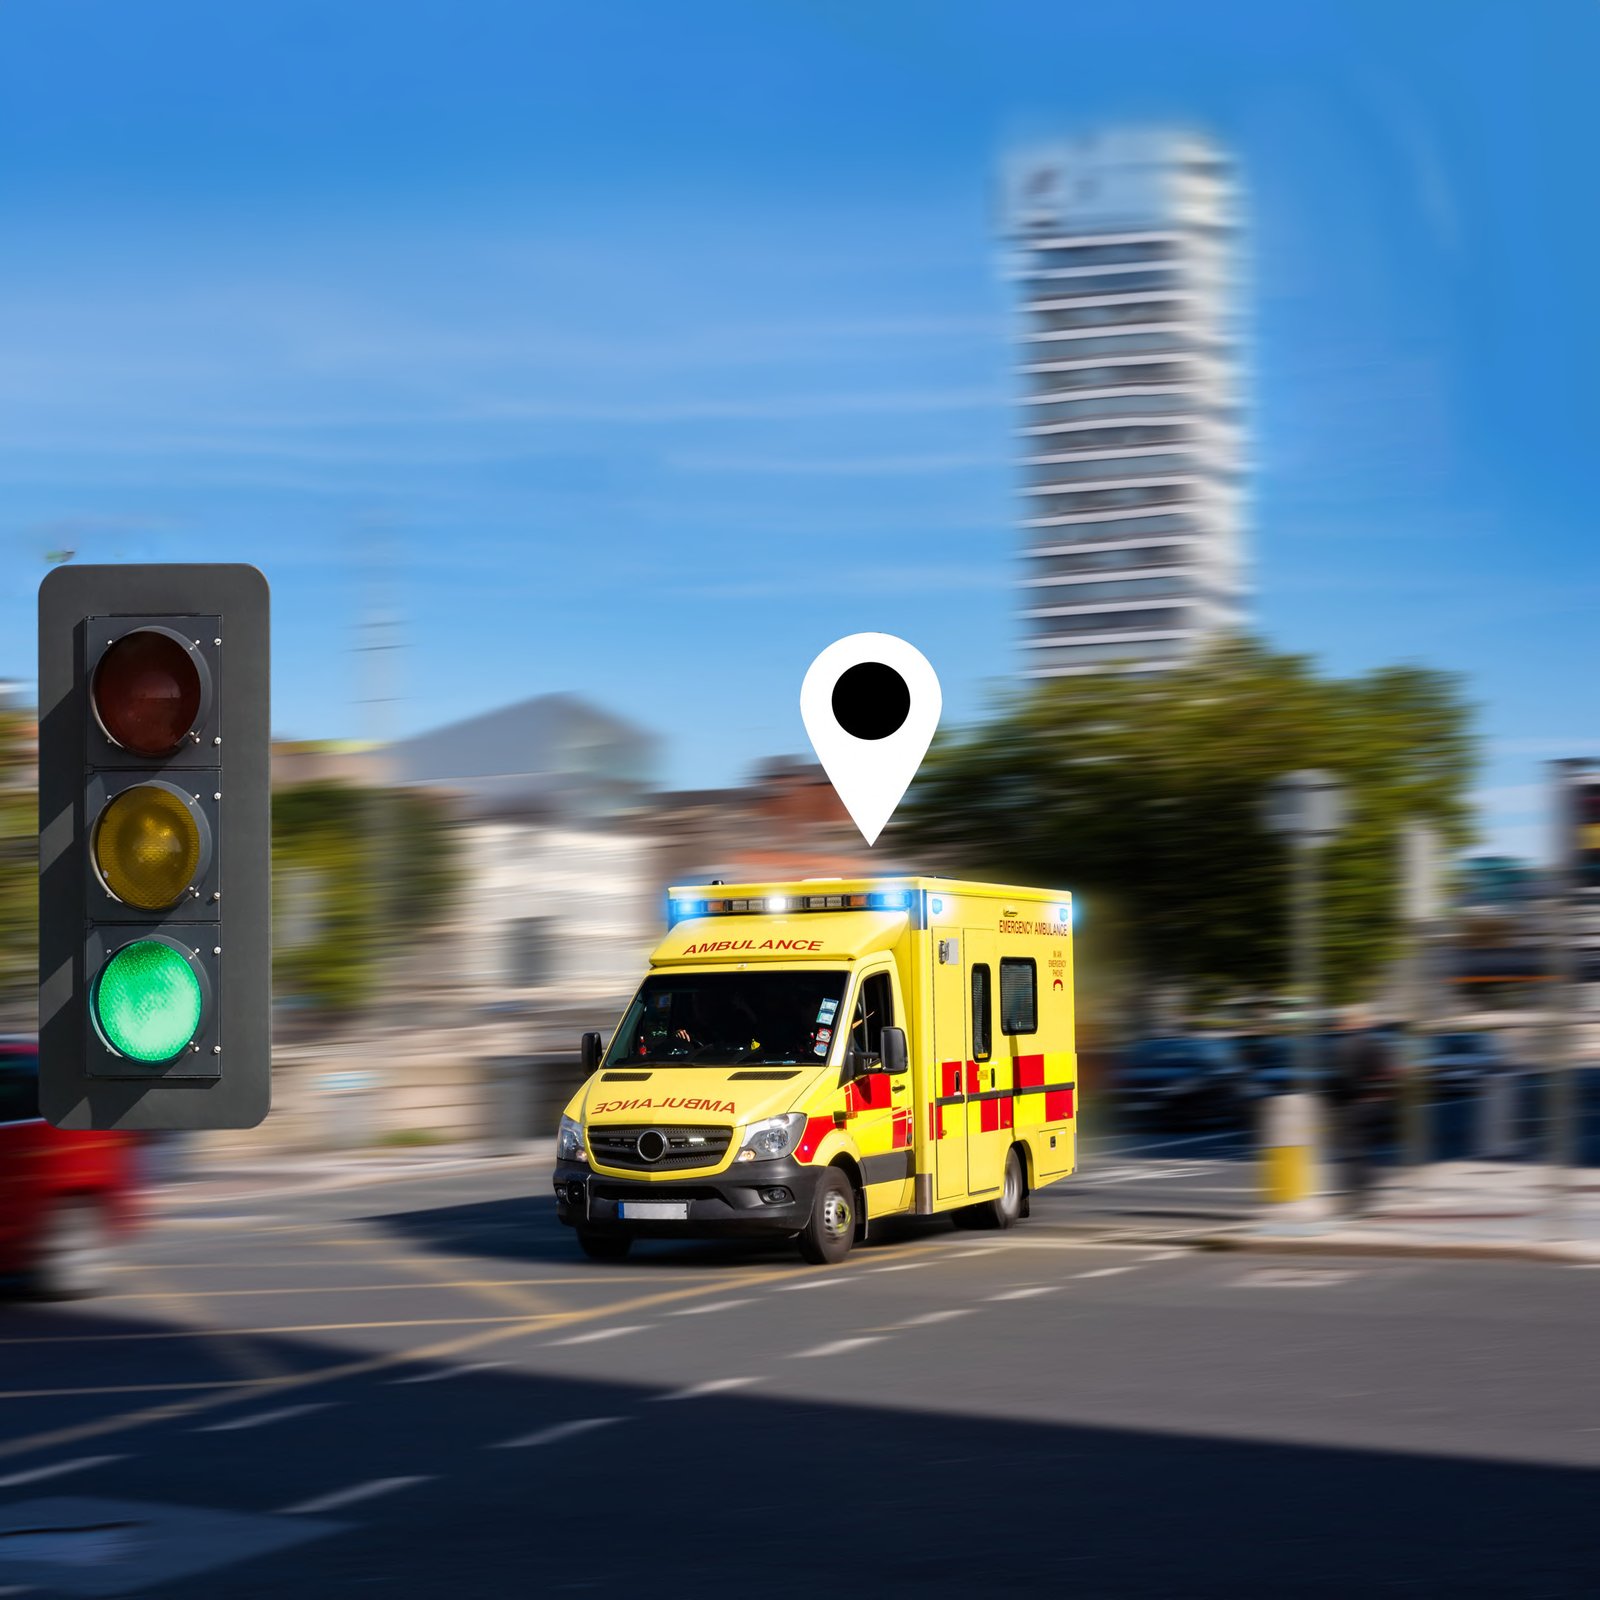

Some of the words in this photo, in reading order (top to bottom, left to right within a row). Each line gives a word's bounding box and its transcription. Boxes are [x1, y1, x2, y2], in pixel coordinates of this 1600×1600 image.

[999, 920, 1033, 934] EMERGENCY
[1034, 921, 1068, 936] AMBULANCE
[682, 939, 824, 955] AMBULANCE
